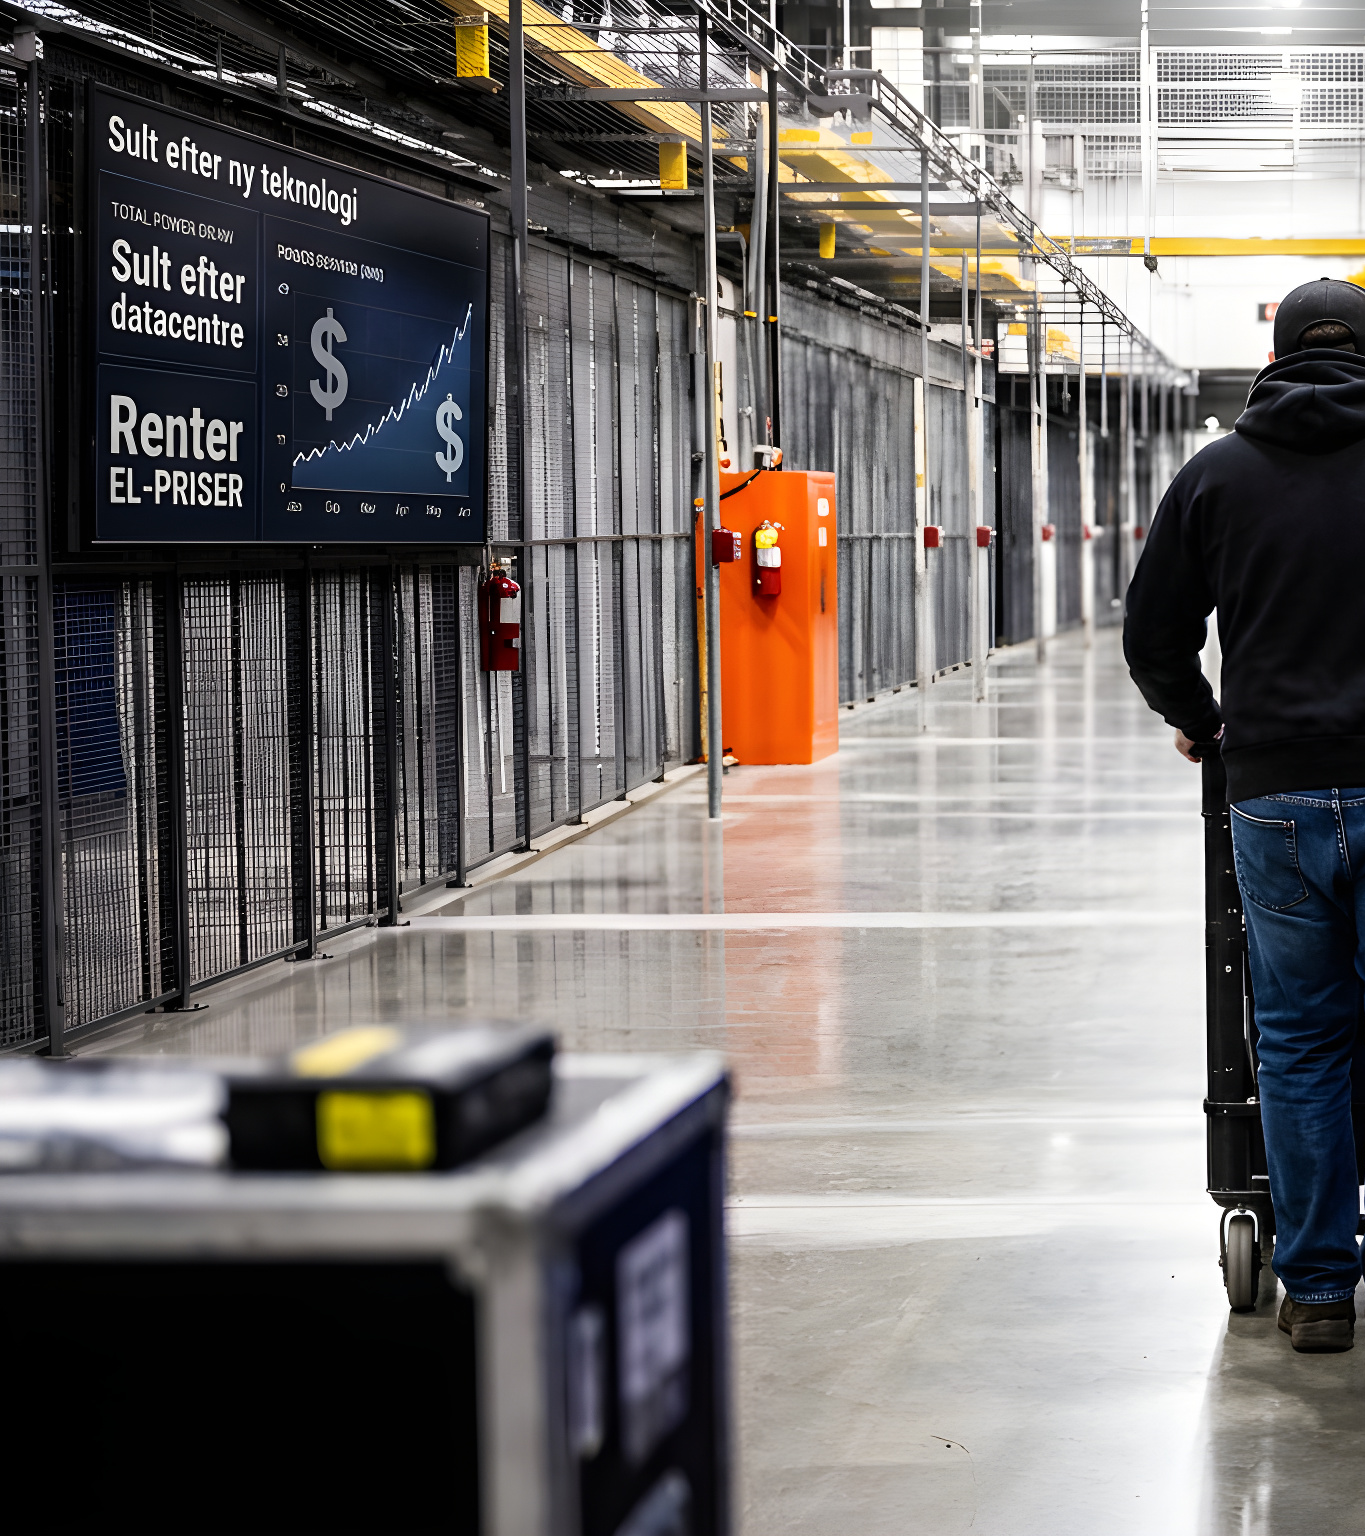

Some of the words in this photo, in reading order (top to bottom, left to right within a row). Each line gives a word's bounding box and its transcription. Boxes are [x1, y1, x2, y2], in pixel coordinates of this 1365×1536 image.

[108, 115, 159, 163] Sult
[165, 135, 223, 181] efter
[229, 159, 256, 199] ny
[260, 163, 358, 226] teknologi
[111, 201, 152, 226] TOTAL
[111, 238, 172, 292] Sult
[180, 255, 246, 304] efter
[110, 291, 245, 349] datacentre
[110, 394, 244, 462] Renter
[110, 466, 243, 508] EL-PRISER
